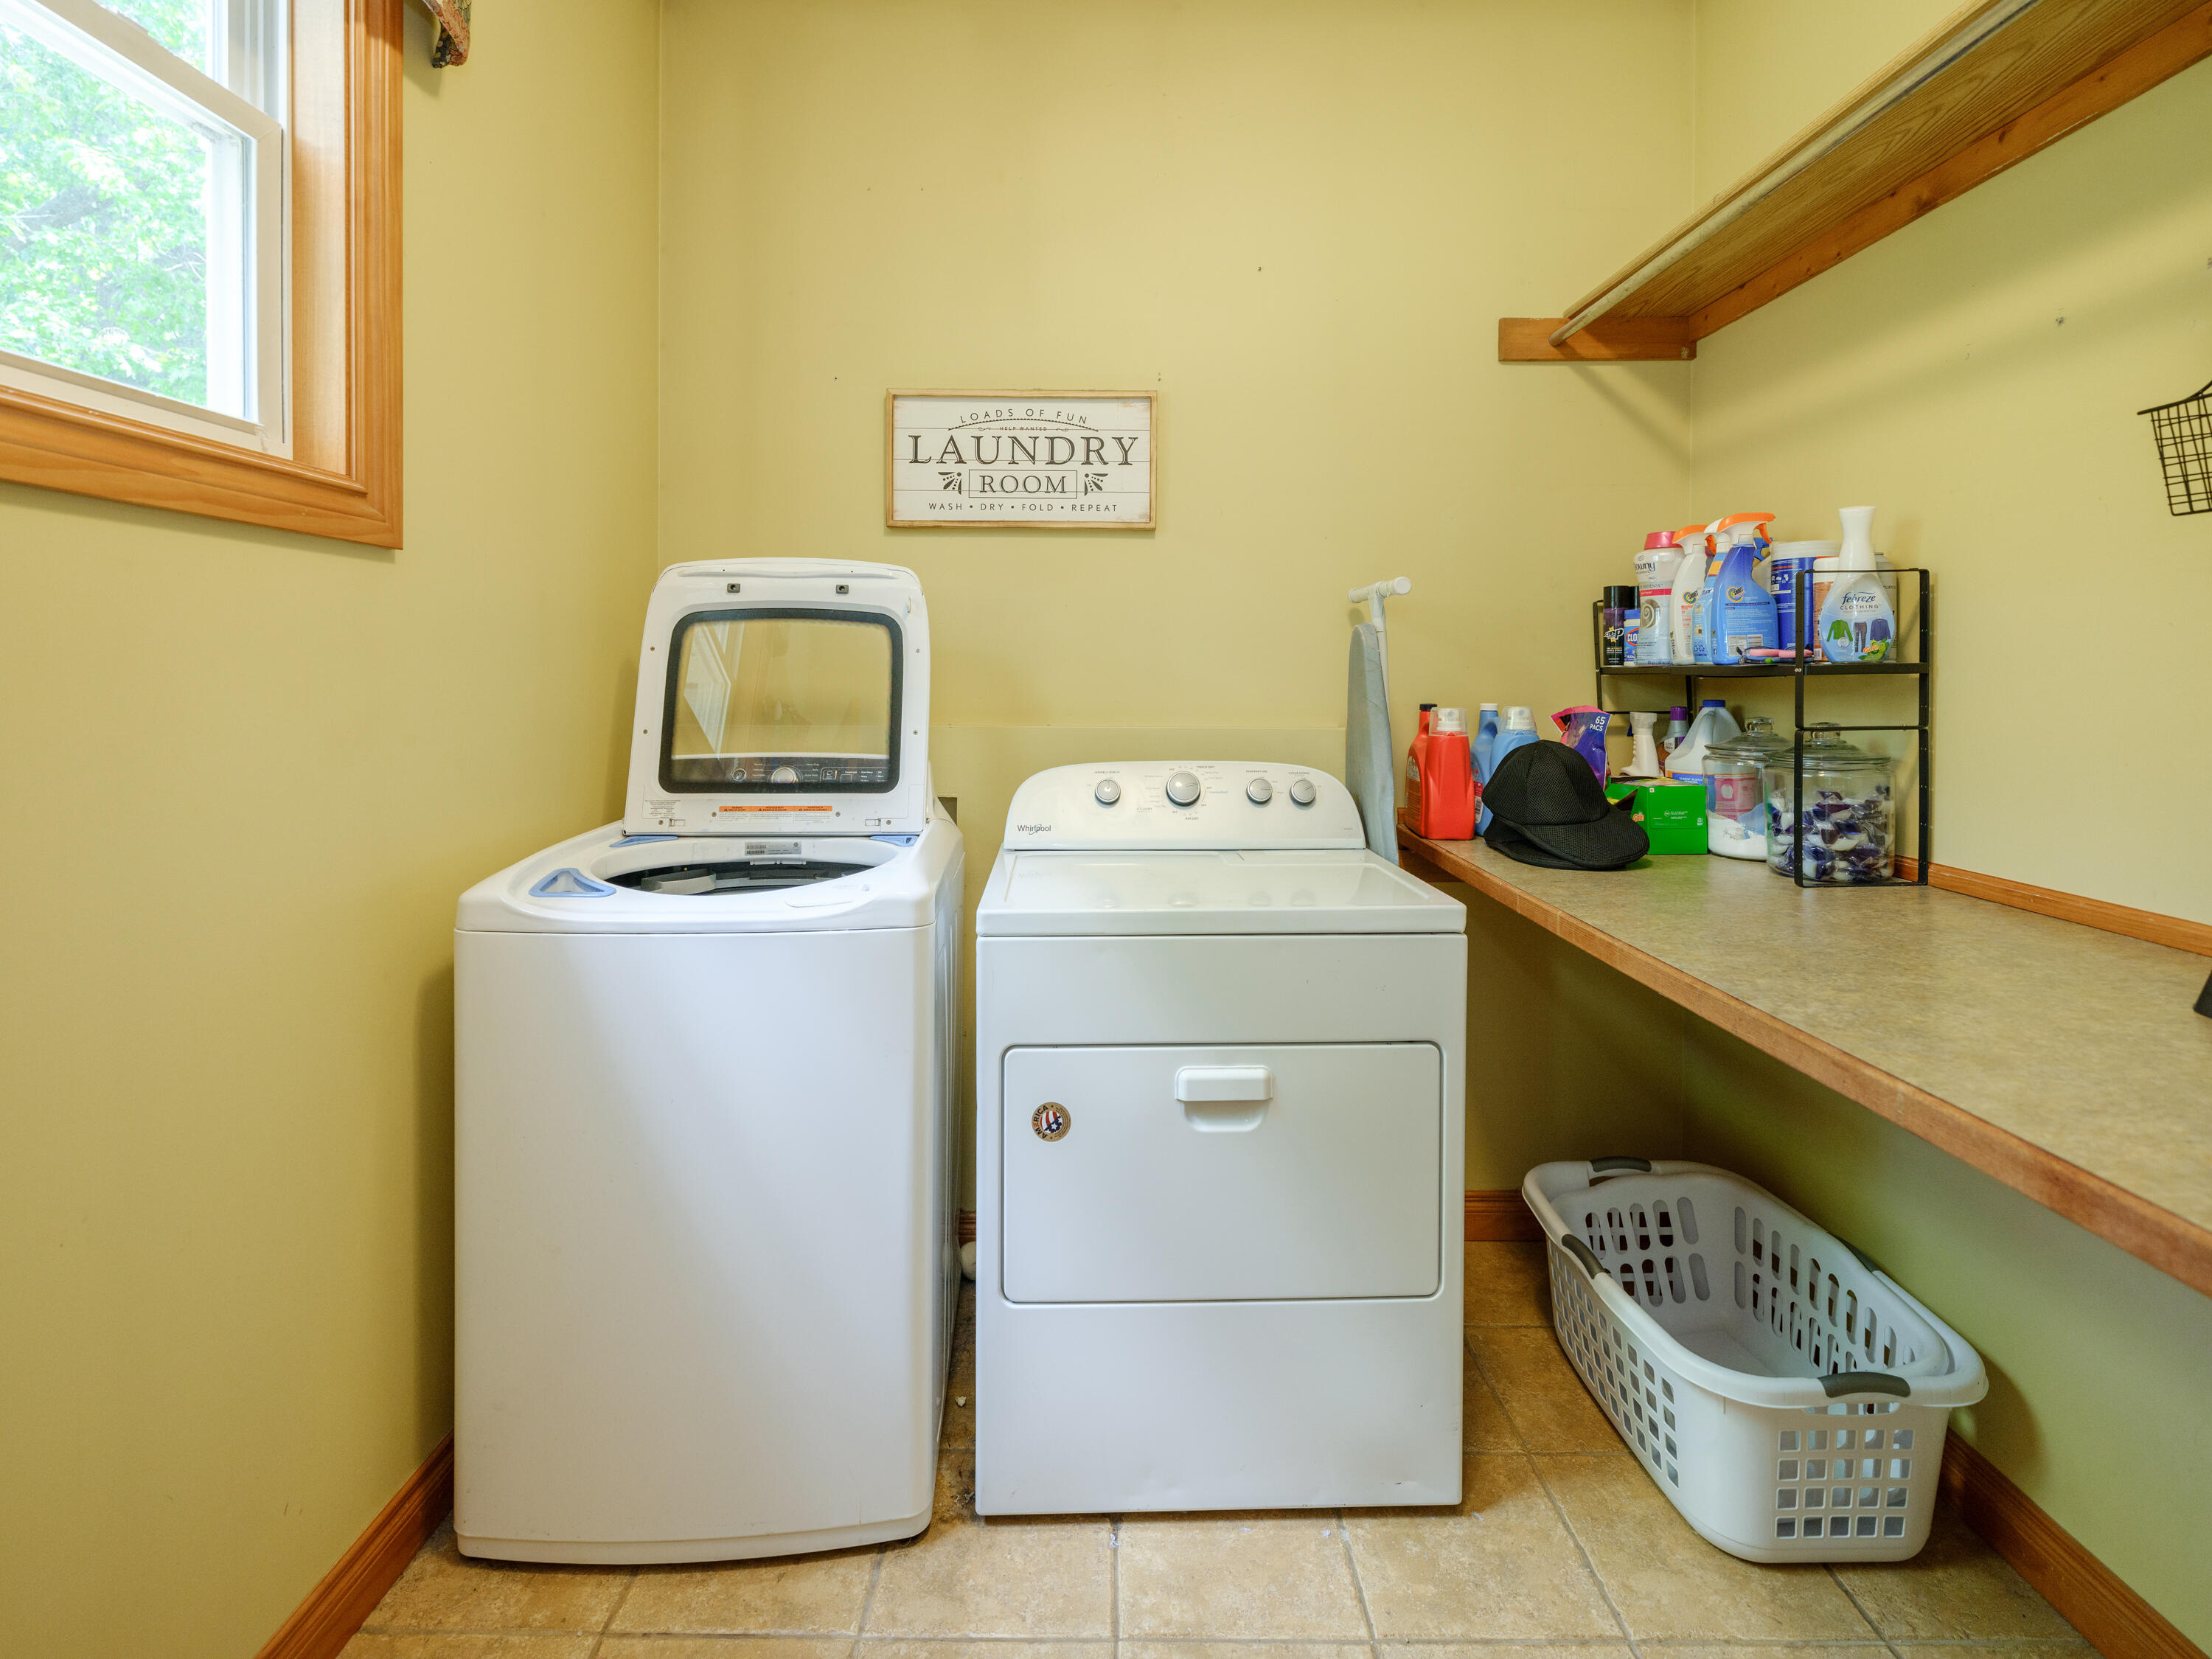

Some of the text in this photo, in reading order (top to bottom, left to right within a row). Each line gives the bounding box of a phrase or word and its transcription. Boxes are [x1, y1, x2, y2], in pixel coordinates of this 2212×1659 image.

[960, 409, 1087, 424] LOADS OF FUN
[908, 434, 1138, 465] LAUNDRY
[979, 476, 1067, 493] ROOM
[1840, 592, 1877, 605] febreze
[1863, 646, 1879, 654] Gain
[1595, 716, 1605, 725] 65
[1590, 723, 1604, 731] PACS
[1632, 813, 1645, 822] Gain
[1017, 824, 1051, 835] Whirlpool
[1033, 1105, 1048, 1139] AMERICA
